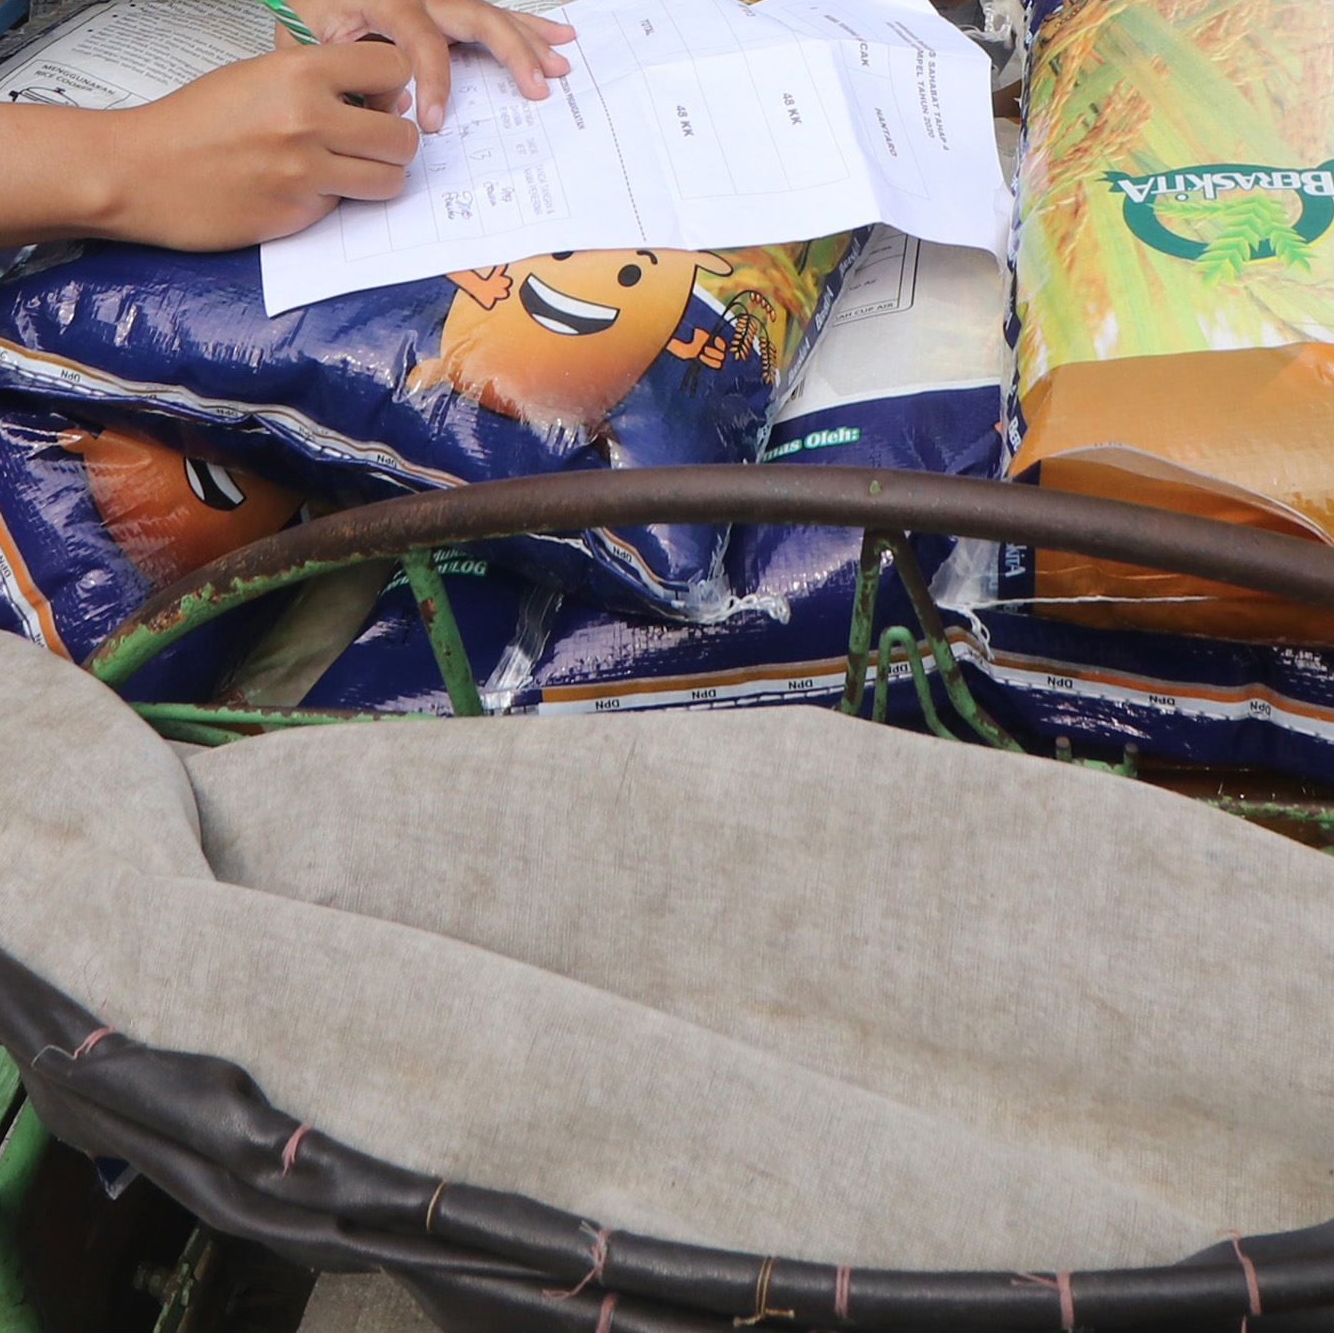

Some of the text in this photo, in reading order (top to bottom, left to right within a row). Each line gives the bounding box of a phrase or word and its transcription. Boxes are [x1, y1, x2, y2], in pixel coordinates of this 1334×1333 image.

[35, 70, 56, 81] RICE
[42, 64, 116, 95] MENGGUNAKAN
[782, 92, 803, 126] 48 KK
[917, 81, 929, 115] TAHUN
[924, 117, 935, 138] 2020
[928, 61, 947, 143] SAHABAT TAHAP
[676, 105, 695, 138] 48 KK
[877, 301, 894, 311] AIR
[805, 427, 861, 450] Oleh:
[437, 560, 487, 576] ULOG
